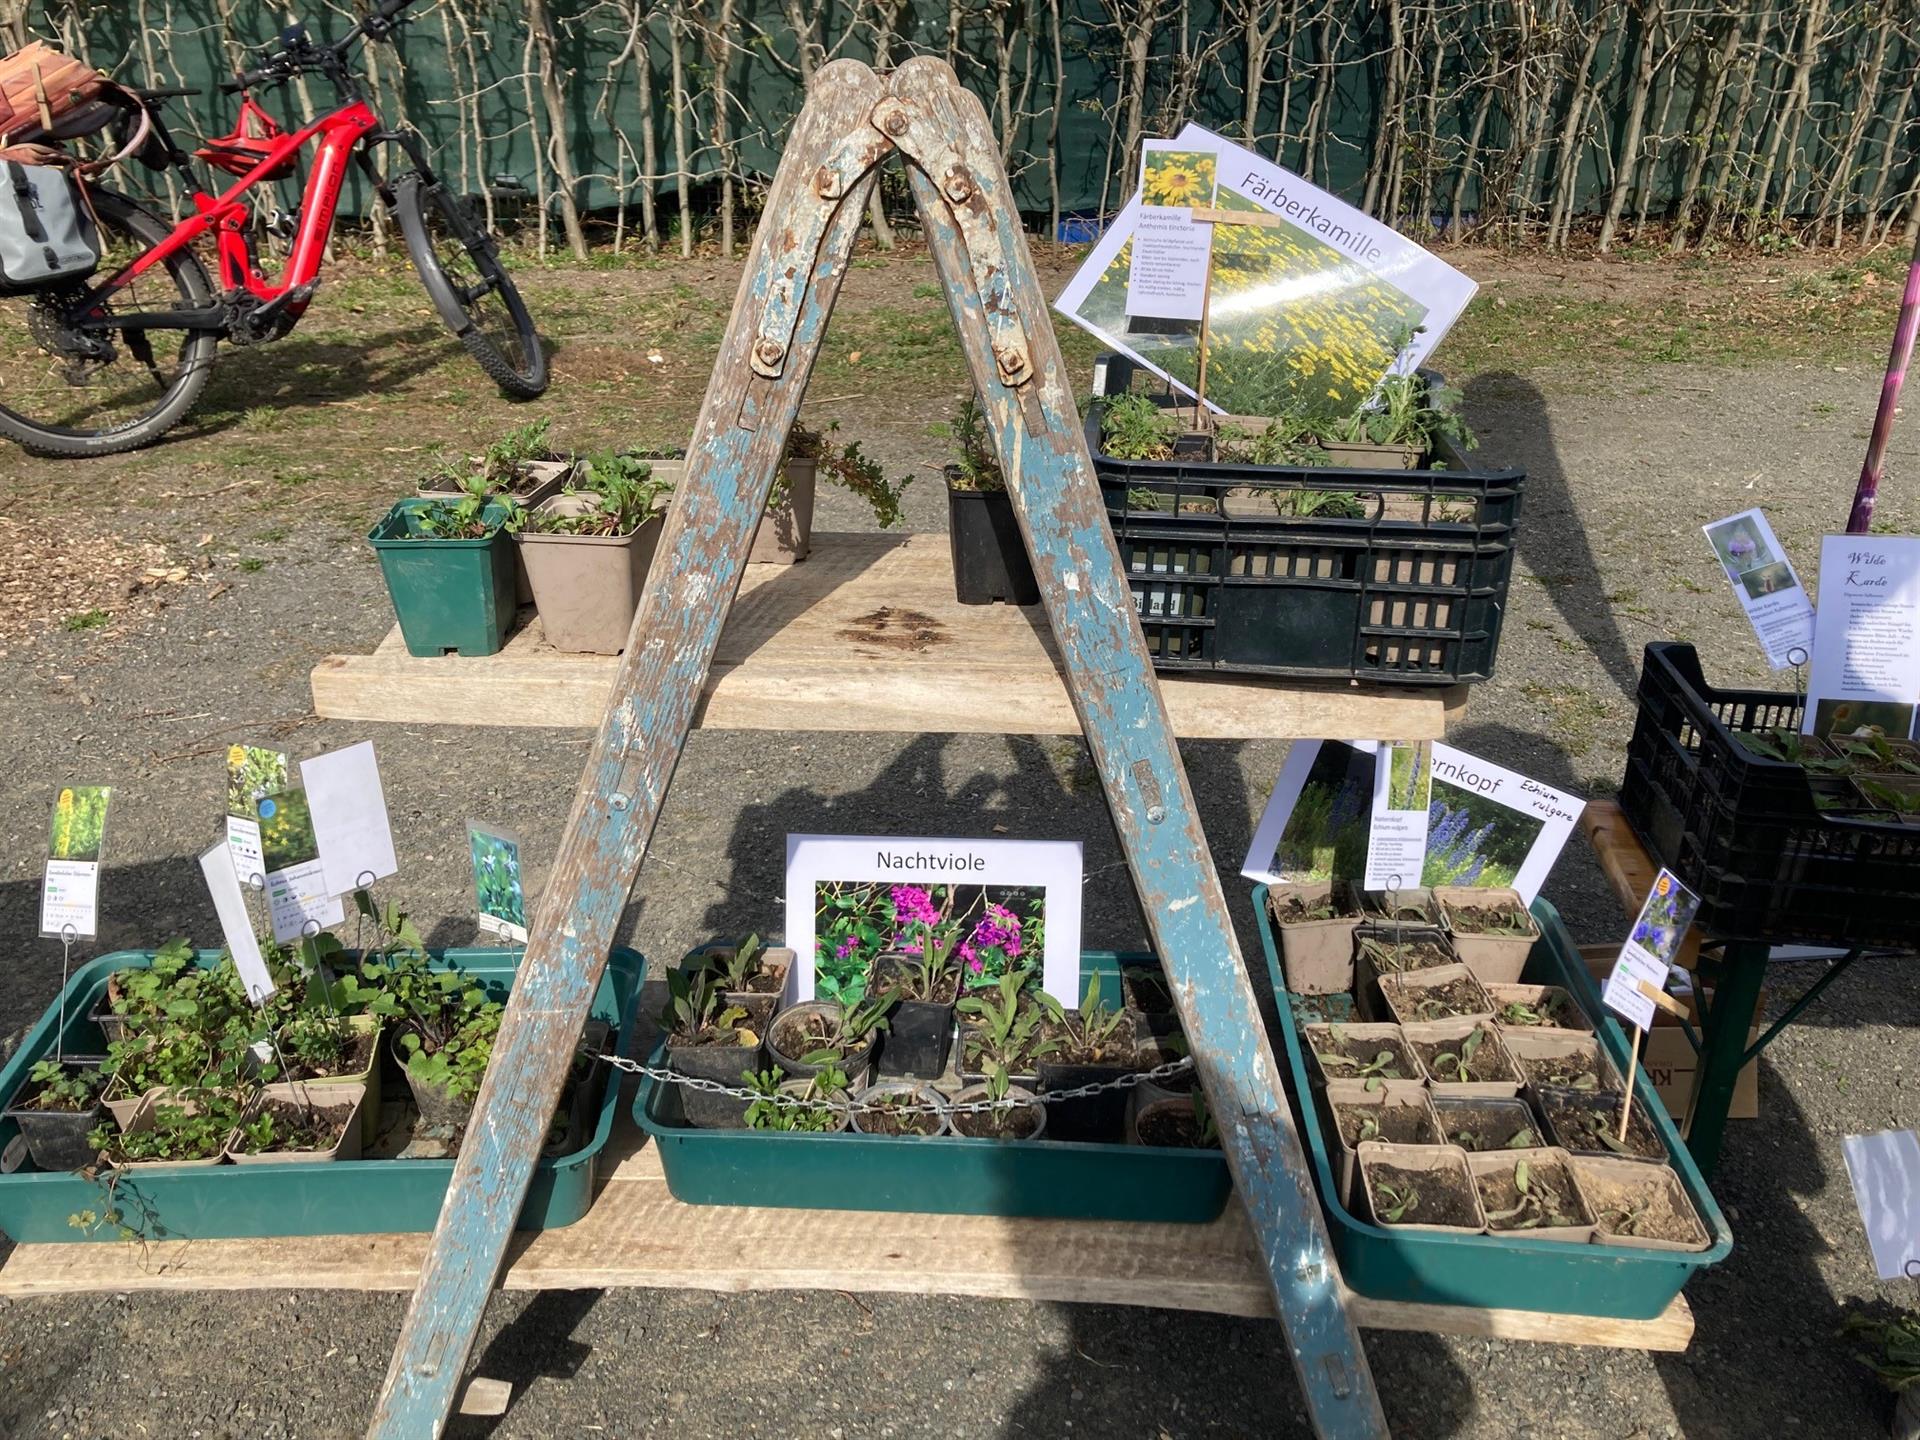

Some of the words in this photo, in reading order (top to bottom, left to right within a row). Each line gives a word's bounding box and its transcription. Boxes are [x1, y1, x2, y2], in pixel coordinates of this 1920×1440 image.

[1240, 172, 1381, 263] Färberkamille
[1848, 551, 1886, 565] Wilde
[1844, 570, 1888, 587] Karde
[1433, 758, 1503, 794] rnkopf
[1520, 780, 1559, 803] Echium
[1532, 800, 1573, 822] vulgare
[877, 851, 985, 871] Nachtviole
